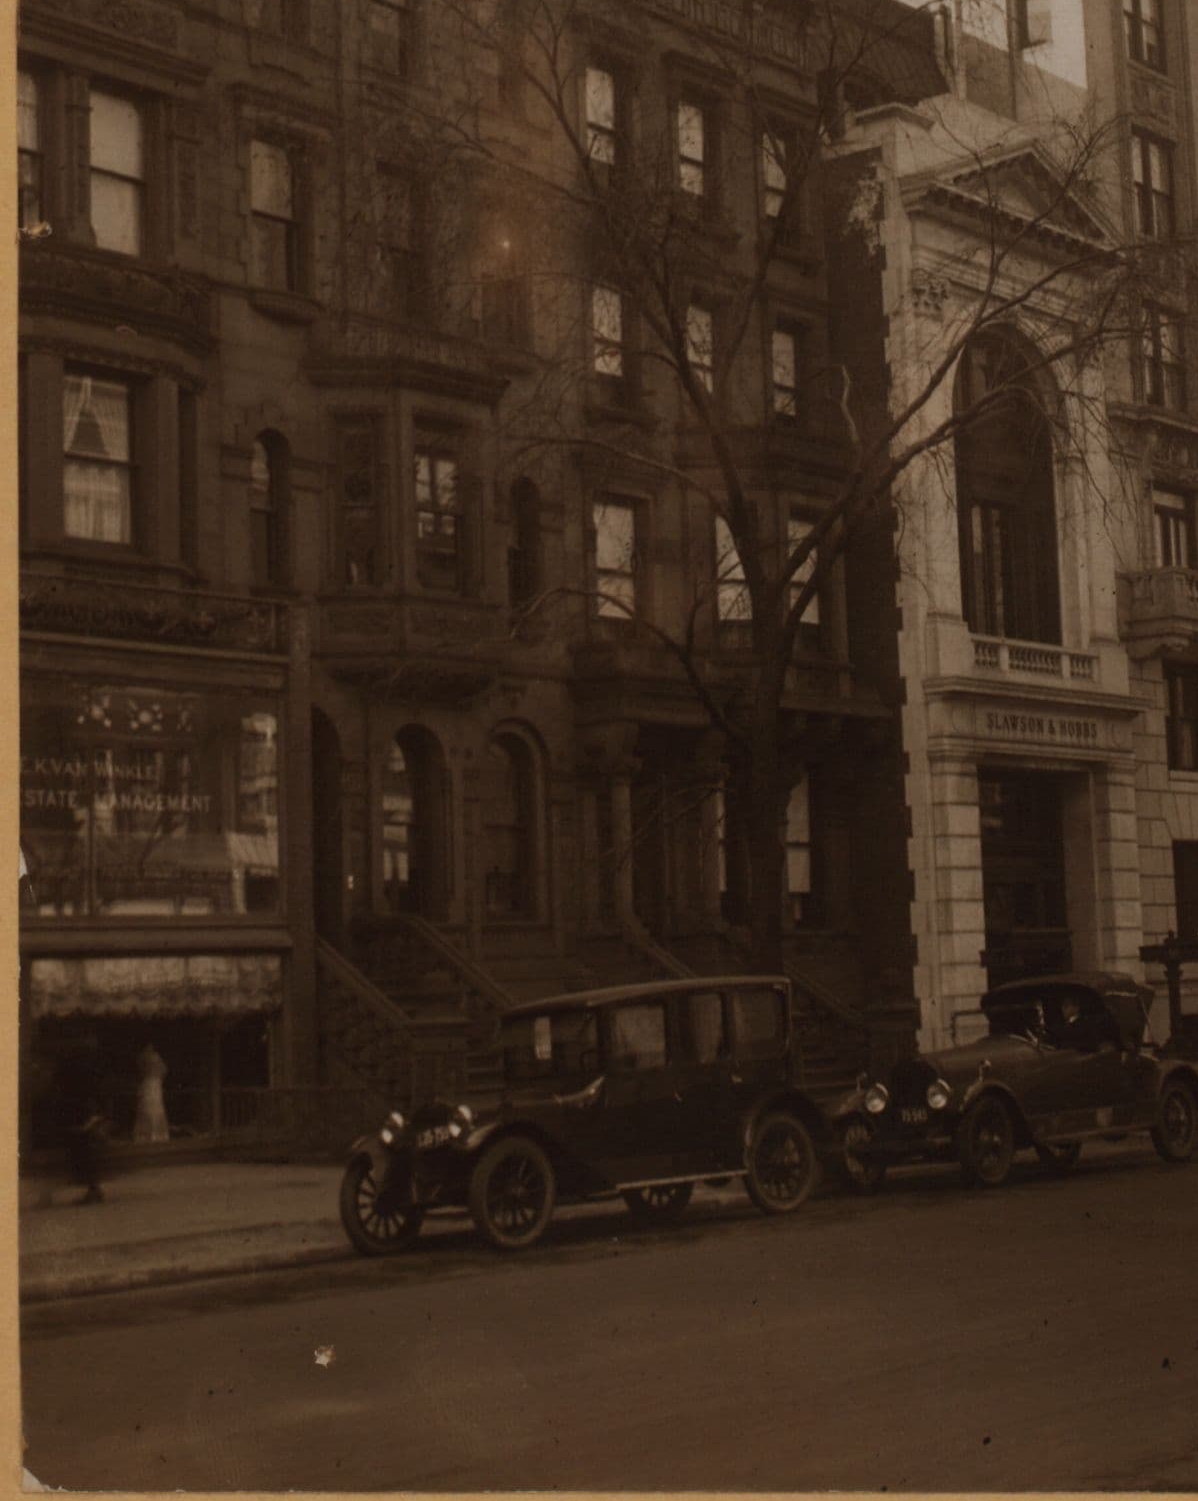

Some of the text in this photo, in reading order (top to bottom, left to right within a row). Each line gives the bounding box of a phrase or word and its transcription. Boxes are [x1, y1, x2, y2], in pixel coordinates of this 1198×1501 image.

[986, 712, 1097, 739] SLAWSON & HOBBS
[93, 759, 155, 782] WINKLE
[22, 789, 211, 813] STATE MANAGEMENT
